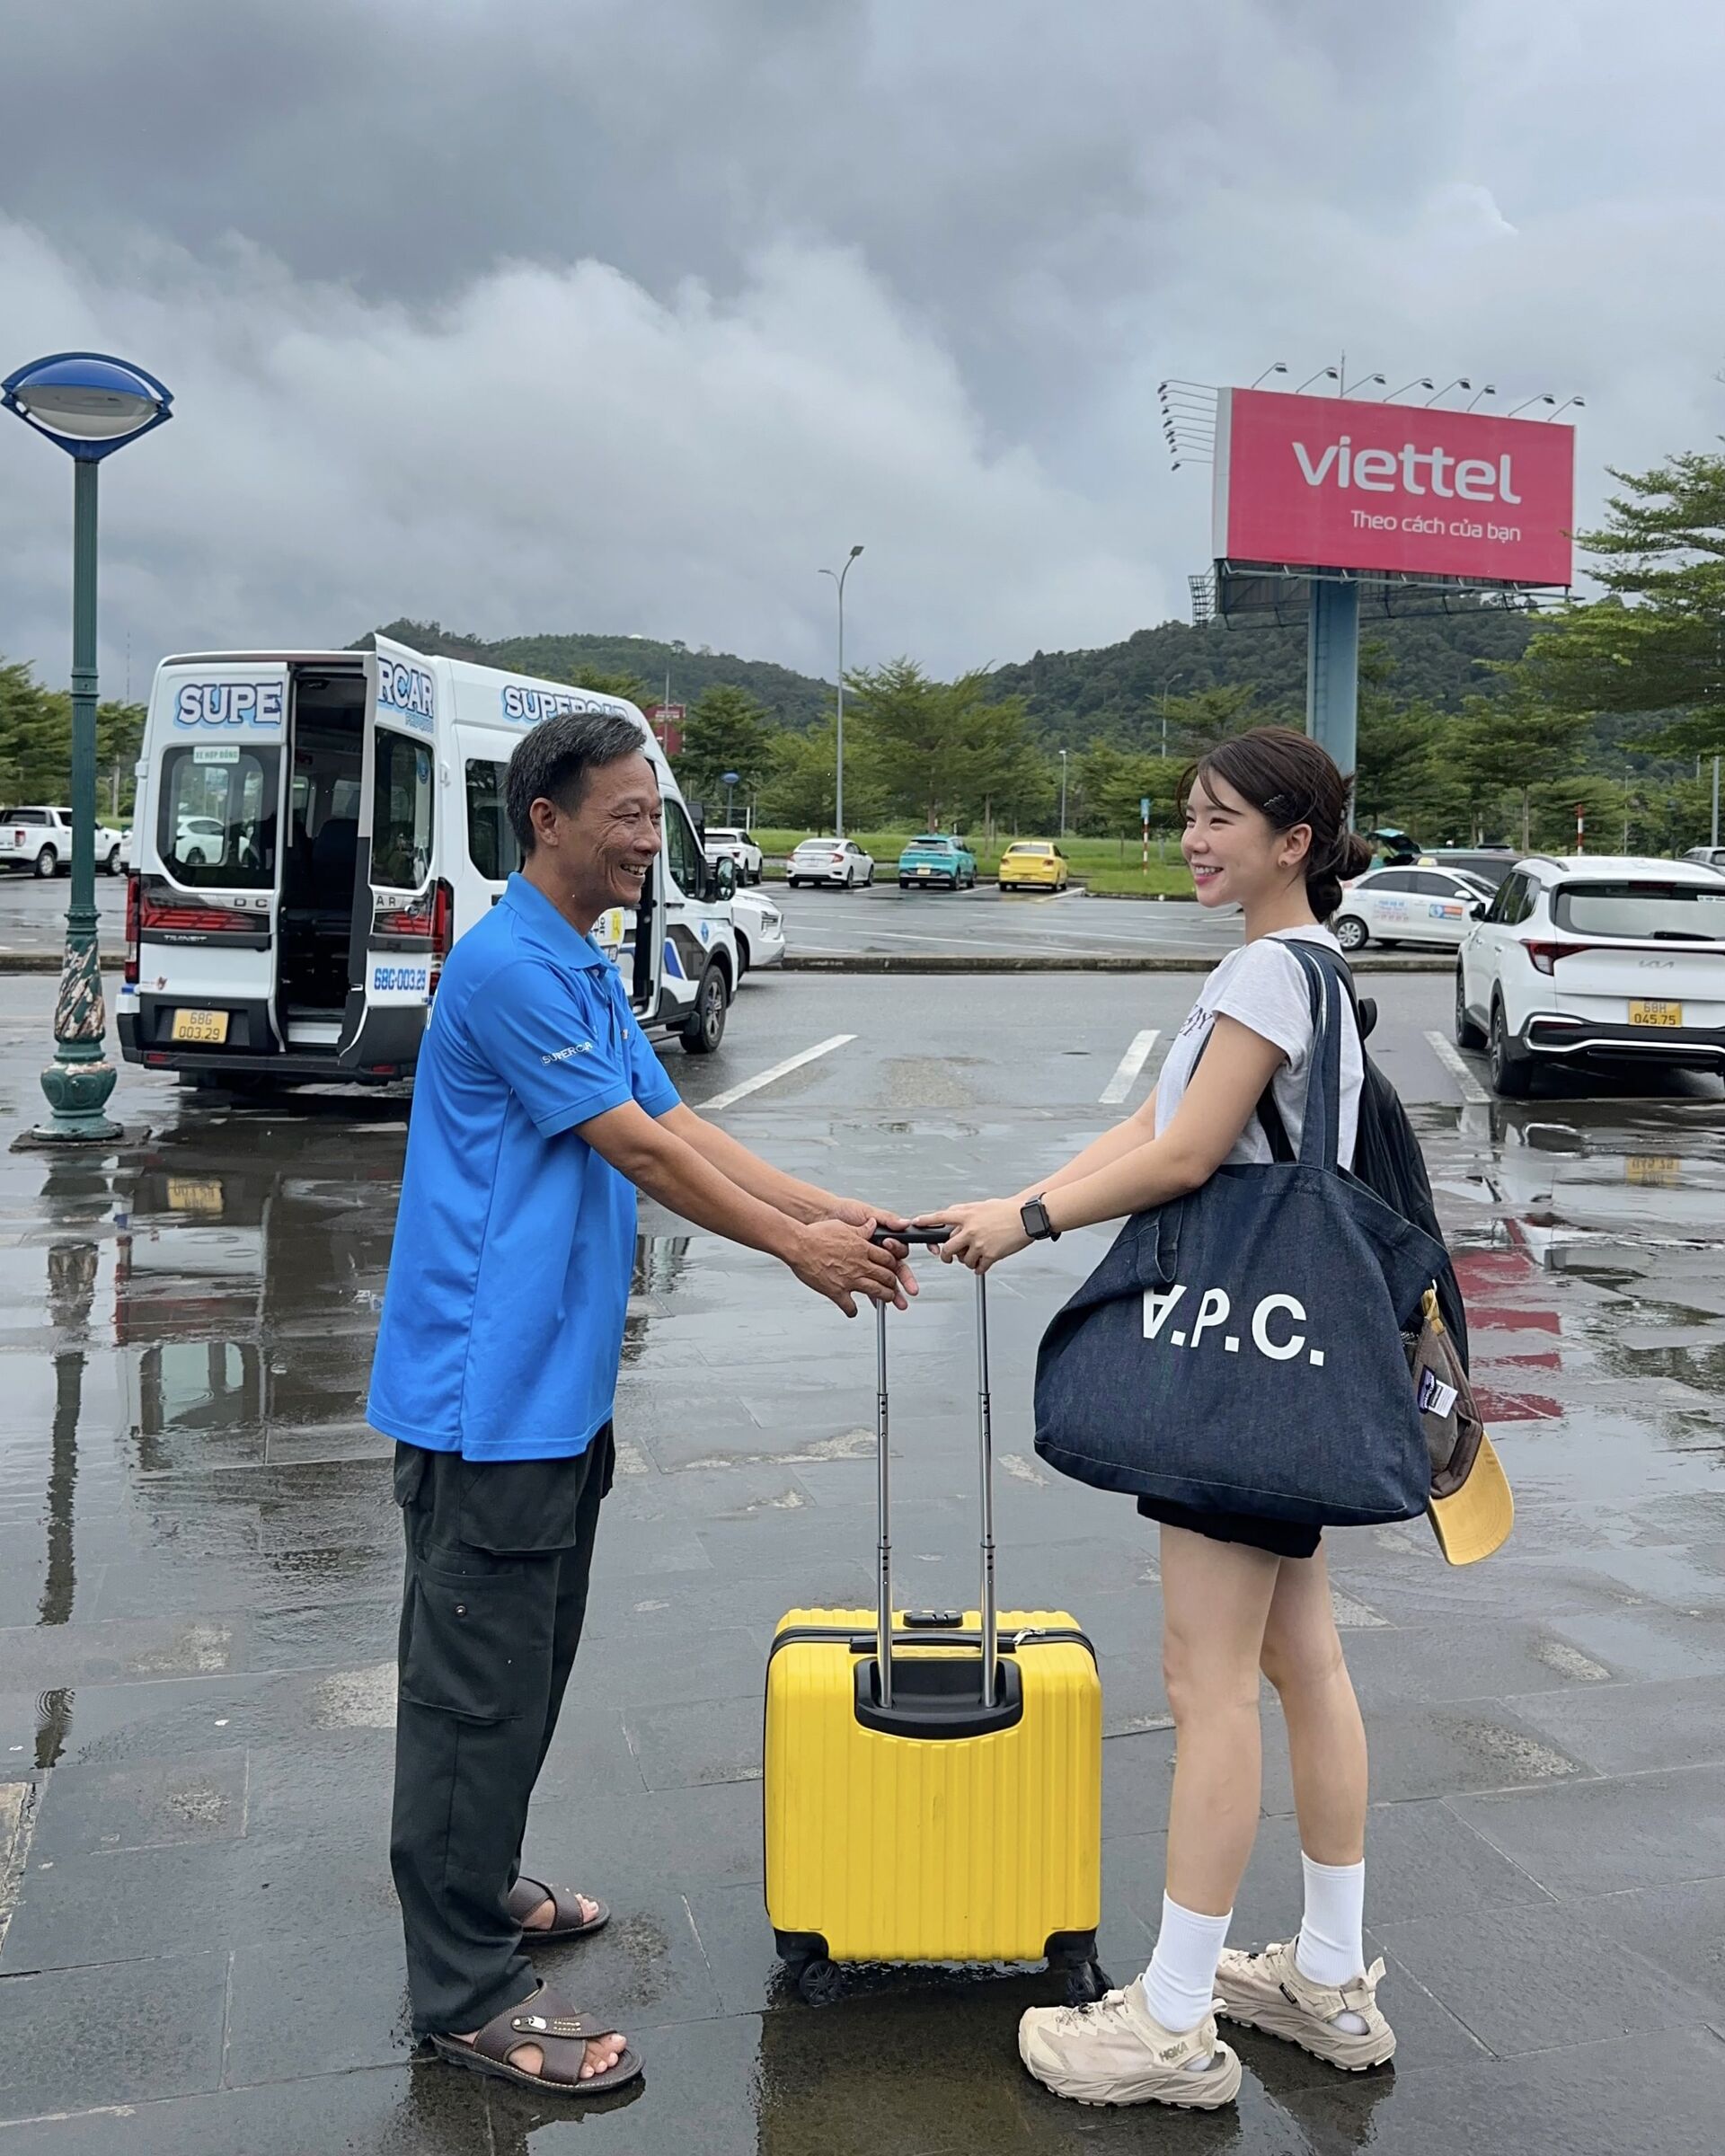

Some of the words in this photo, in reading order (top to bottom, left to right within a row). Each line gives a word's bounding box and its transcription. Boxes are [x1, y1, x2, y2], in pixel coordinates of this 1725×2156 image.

[1292, 436, 1521, 504] viettel
[1351, 509, 1397, 530] Theo
[1402, 515, 1445, 535] cách
[1449, 518, 1483, 538] của
[1487, 523, 1521, 543] bạn
[377, 657, 434, 719] RCAR
[374, 968, 427, 991] 68G-003.29
[190, 1012, 213, 1025] 68G
[1634, 1012, 1676, 1026] 045.75
[1643, 1002, 1667, 1014] 68H
[180, 1026, 220, 1040] 003.29
[1159, 2040, 1190, 2063] HOKA
